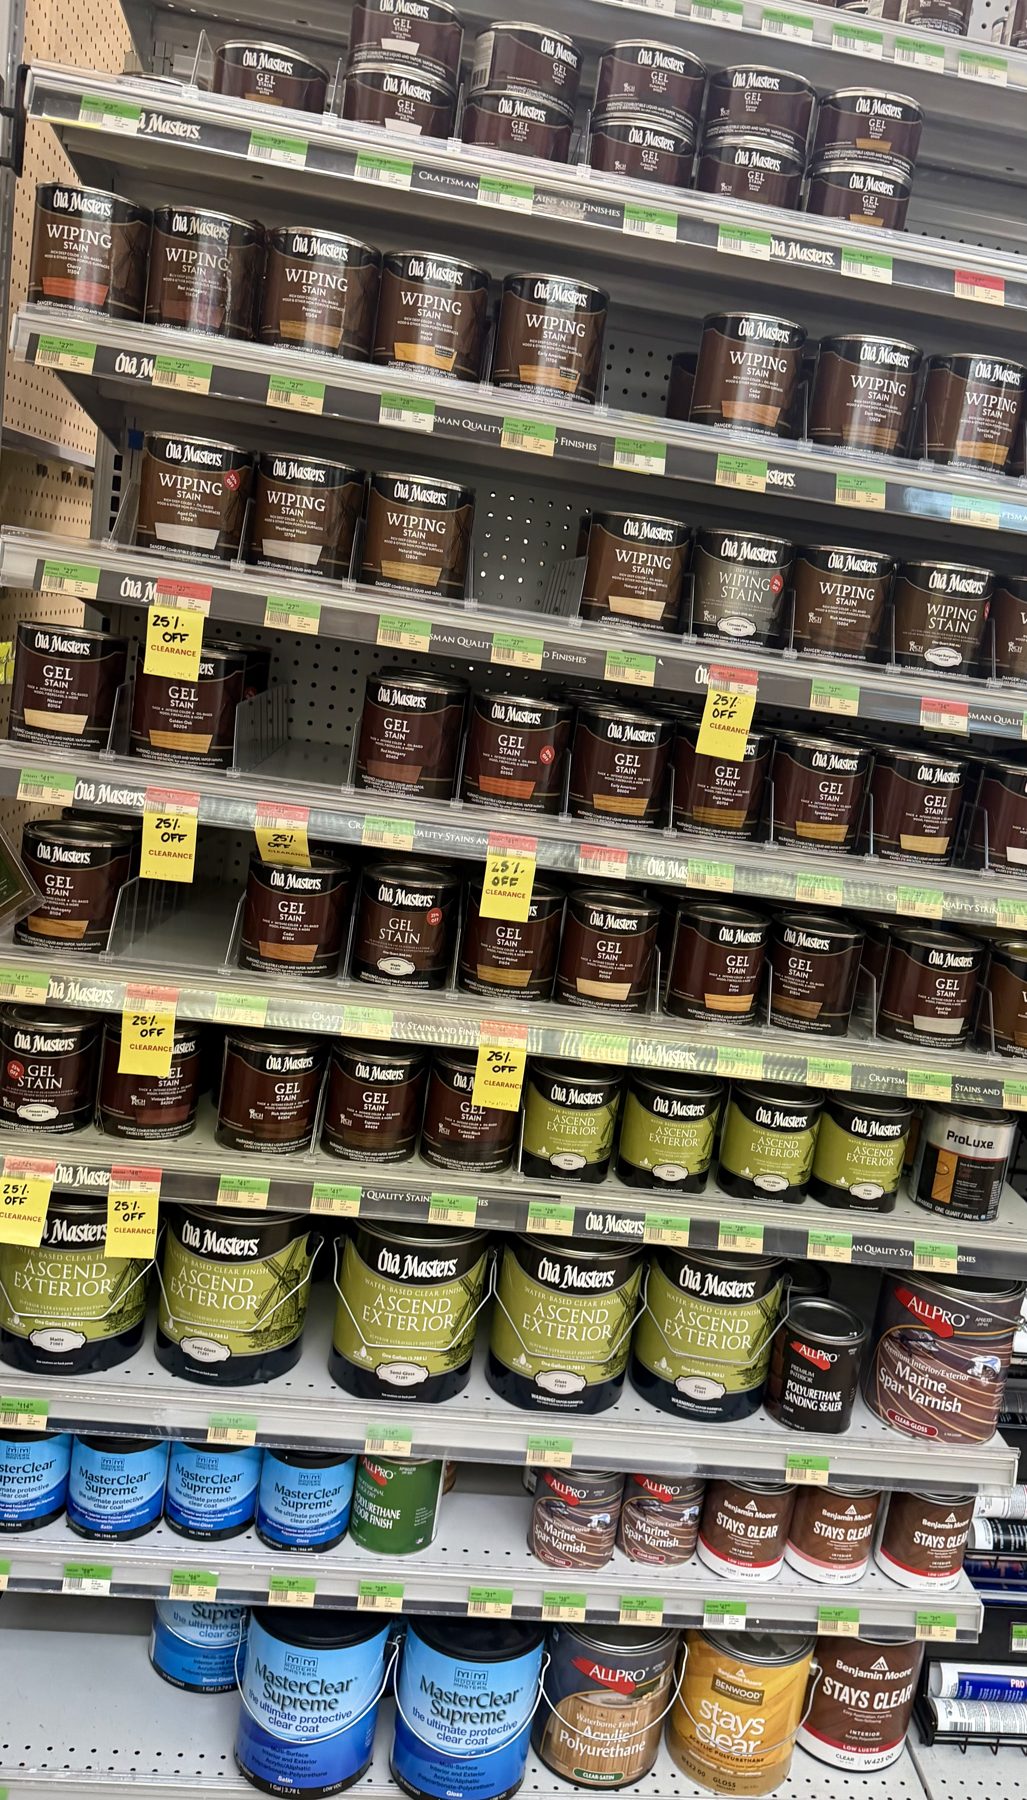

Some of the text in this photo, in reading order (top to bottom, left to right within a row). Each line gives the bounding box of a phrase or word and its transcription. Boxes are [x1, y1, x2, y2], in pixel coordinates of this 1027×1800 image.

[393, 18, 411, 29] GEL
[243, 49, 293, 74] Old Masters
[638, 49, 685, 73] Old Masters
[256, 73, 276, 85] GEL
[733, 72, 780, 90] Old Masters
[745, 92, 762, 102] GEL
[148, 113, 201, 139] Masters
[868, 119, 886, 130] GEL
[418, 170, 478, 189] CRAFTSMAN
[583, 204, 621, 218] FINISHES
[63, 241, 89, 254] STAIN
[293, 234, 349, 261] Old Masters
[166, 248, 229, 272] WIPING
[285, 268, 348, 292] WIPING
[408, 259, 463, 284] Old Masters
[302, 285, 326, 296] STAIN
[526, 314, 586, 337] WIPING
[115, 352, 137, 375] Old
[730, 351, 787, 373] WIPING
[747, 368, 769, 377] STAIN
[966, 392, 1017, 414] WIPING
[560, 437, 597, 451] FINISHES
[166, 442, 222, 467] Old Masters
[159, 473, 223, 496] WIPING
[387, 512, 446, 534] WIPING
[615, 549, 672, 570] WIPING
[721, 538, 778, 563] Old Masters
[720, 587, 763, 603] STAIN
[820, 582, 875, 601] WIPING
[926, 603, 978, 622] WIPING
[928, 617, 971, 634] STAIN
[35, 631, 90, 656] Old Masters
[550, 652, 587, 664] FINISHES
[43, 665, 74, 681] GEL
[168, 686, 199, 702] GEL
[713, 695, 738, 708] 25%
[712, 709, 737, 720] OFF
[383, 718, 410, 733] GEL
[614, 753, 641, 767] GEL
[812, 751, 859, 771] Old Masters
[714, 766, 741, 780] GEL
[74, 780, 145, 807] Old Masters
[924, 795, 947, 808] GEL
[161, 832, 188, 843] OFF
[148, 849, 193, 860] CLEARANCE
[491, 877, 519, 887] OFF
[485, 888, 526, 899] CLEARANCE
[278, 901, 306, 915] GEL
[388, 918, 414, 931] GEL
[379, 928, 421, 944] STAIN
[719, 927, 763, 944] Old Masters
[788, 958, 813, 972] GEL
[935, 978, 959, 991] GEL
[140, 1027, 166, 1037] OFF
[14, 1032, 75, 1054] Old Masters
[129, 1043, 173, 1052] CLEARANCE
[27, 1064, 55, 1077] GEL
[492, 1065, 517, 1073] OFF
[17, 1076, 63, 1090] STAIN
[275, 1082, 301, 1095] GEL
[362, 1092, 389, 1104] GEL
[758, 1136, 799, 1150] ASCEND
[947, 1130, 994, 1149] ProLuxe
[751, 1144, 802, 1159] EXTERIOR
[122, 1213, 145, 1222] OFF
[113, 1227, 155, 1235] CLEARANCE
[182, 1220, 259, 1256] Old Masters
[864, 1244, 897, 1256] QUALITY
[24, 1260, 107, 1279] ASCEND
[560, 1260, 615, 1289] Masters
[14, 1272, 113, 1297] EXTERIOR
[178, 1266, 254, 1293] ASCEND
[171, 1279, 259, 1310] EXTERIOR
[533, 1304, 609, 1326] ASCEND
[907, 1295, 966, 1328] ALLPRO
[664, 1318, 752, 1349] EXTERIOR
[799, 1345, 838, 1363] ALLPRO
[895, 1362, 947, 1394] Marine
[915, 1359, 970, 1382] Interior/Exterior
[786, 1379, 842, 1401] POLYURETHANE
[879, 1371, 962, 1413] Spar Varnish
[784, 1390, 843, 1412] SANDING SEALER
[79, 1467, 148, 1485] MasterClear
[84, 1481, 138, 1497] Supreme
[274, 1483, 341, 1500] MasterClear
[724, 1500, 775, 1519] Benjamin Moore
[370, 1512, 393, 1530] FINISH
[636, 1519, 669, 1539] Marine
[716, 1512, 778, 1538] STAYS CLEAR
[534, 1525, 587, 1554] Spar Varnish
[255, 1657, 353, 1696] MasterClear
[589, 1663, 646, 1682] ALLPRO
[836, 1659, 912, 1681] Benjamin Moore
[715, 1679, 760, 1699] BENWOOD
[1011, 1679, 1025, 1688] PRO
[263, 1684, 339, 1712] Supreme
[823, 1676, 912, 1710] STAYS CLEAR
[259, 1702, 352, 1724] ultimate protective
[576, 1712, 617, 1729] Waterborne
[700, 1700, 765, 1738] stays
[437, 1732, 488, 1745] clear coat
[559, 1729, 645, 1759] Polyurethane
[696, 1722, 760, 1758] clear
[713, 1776, 736, 1788] GLOSS
